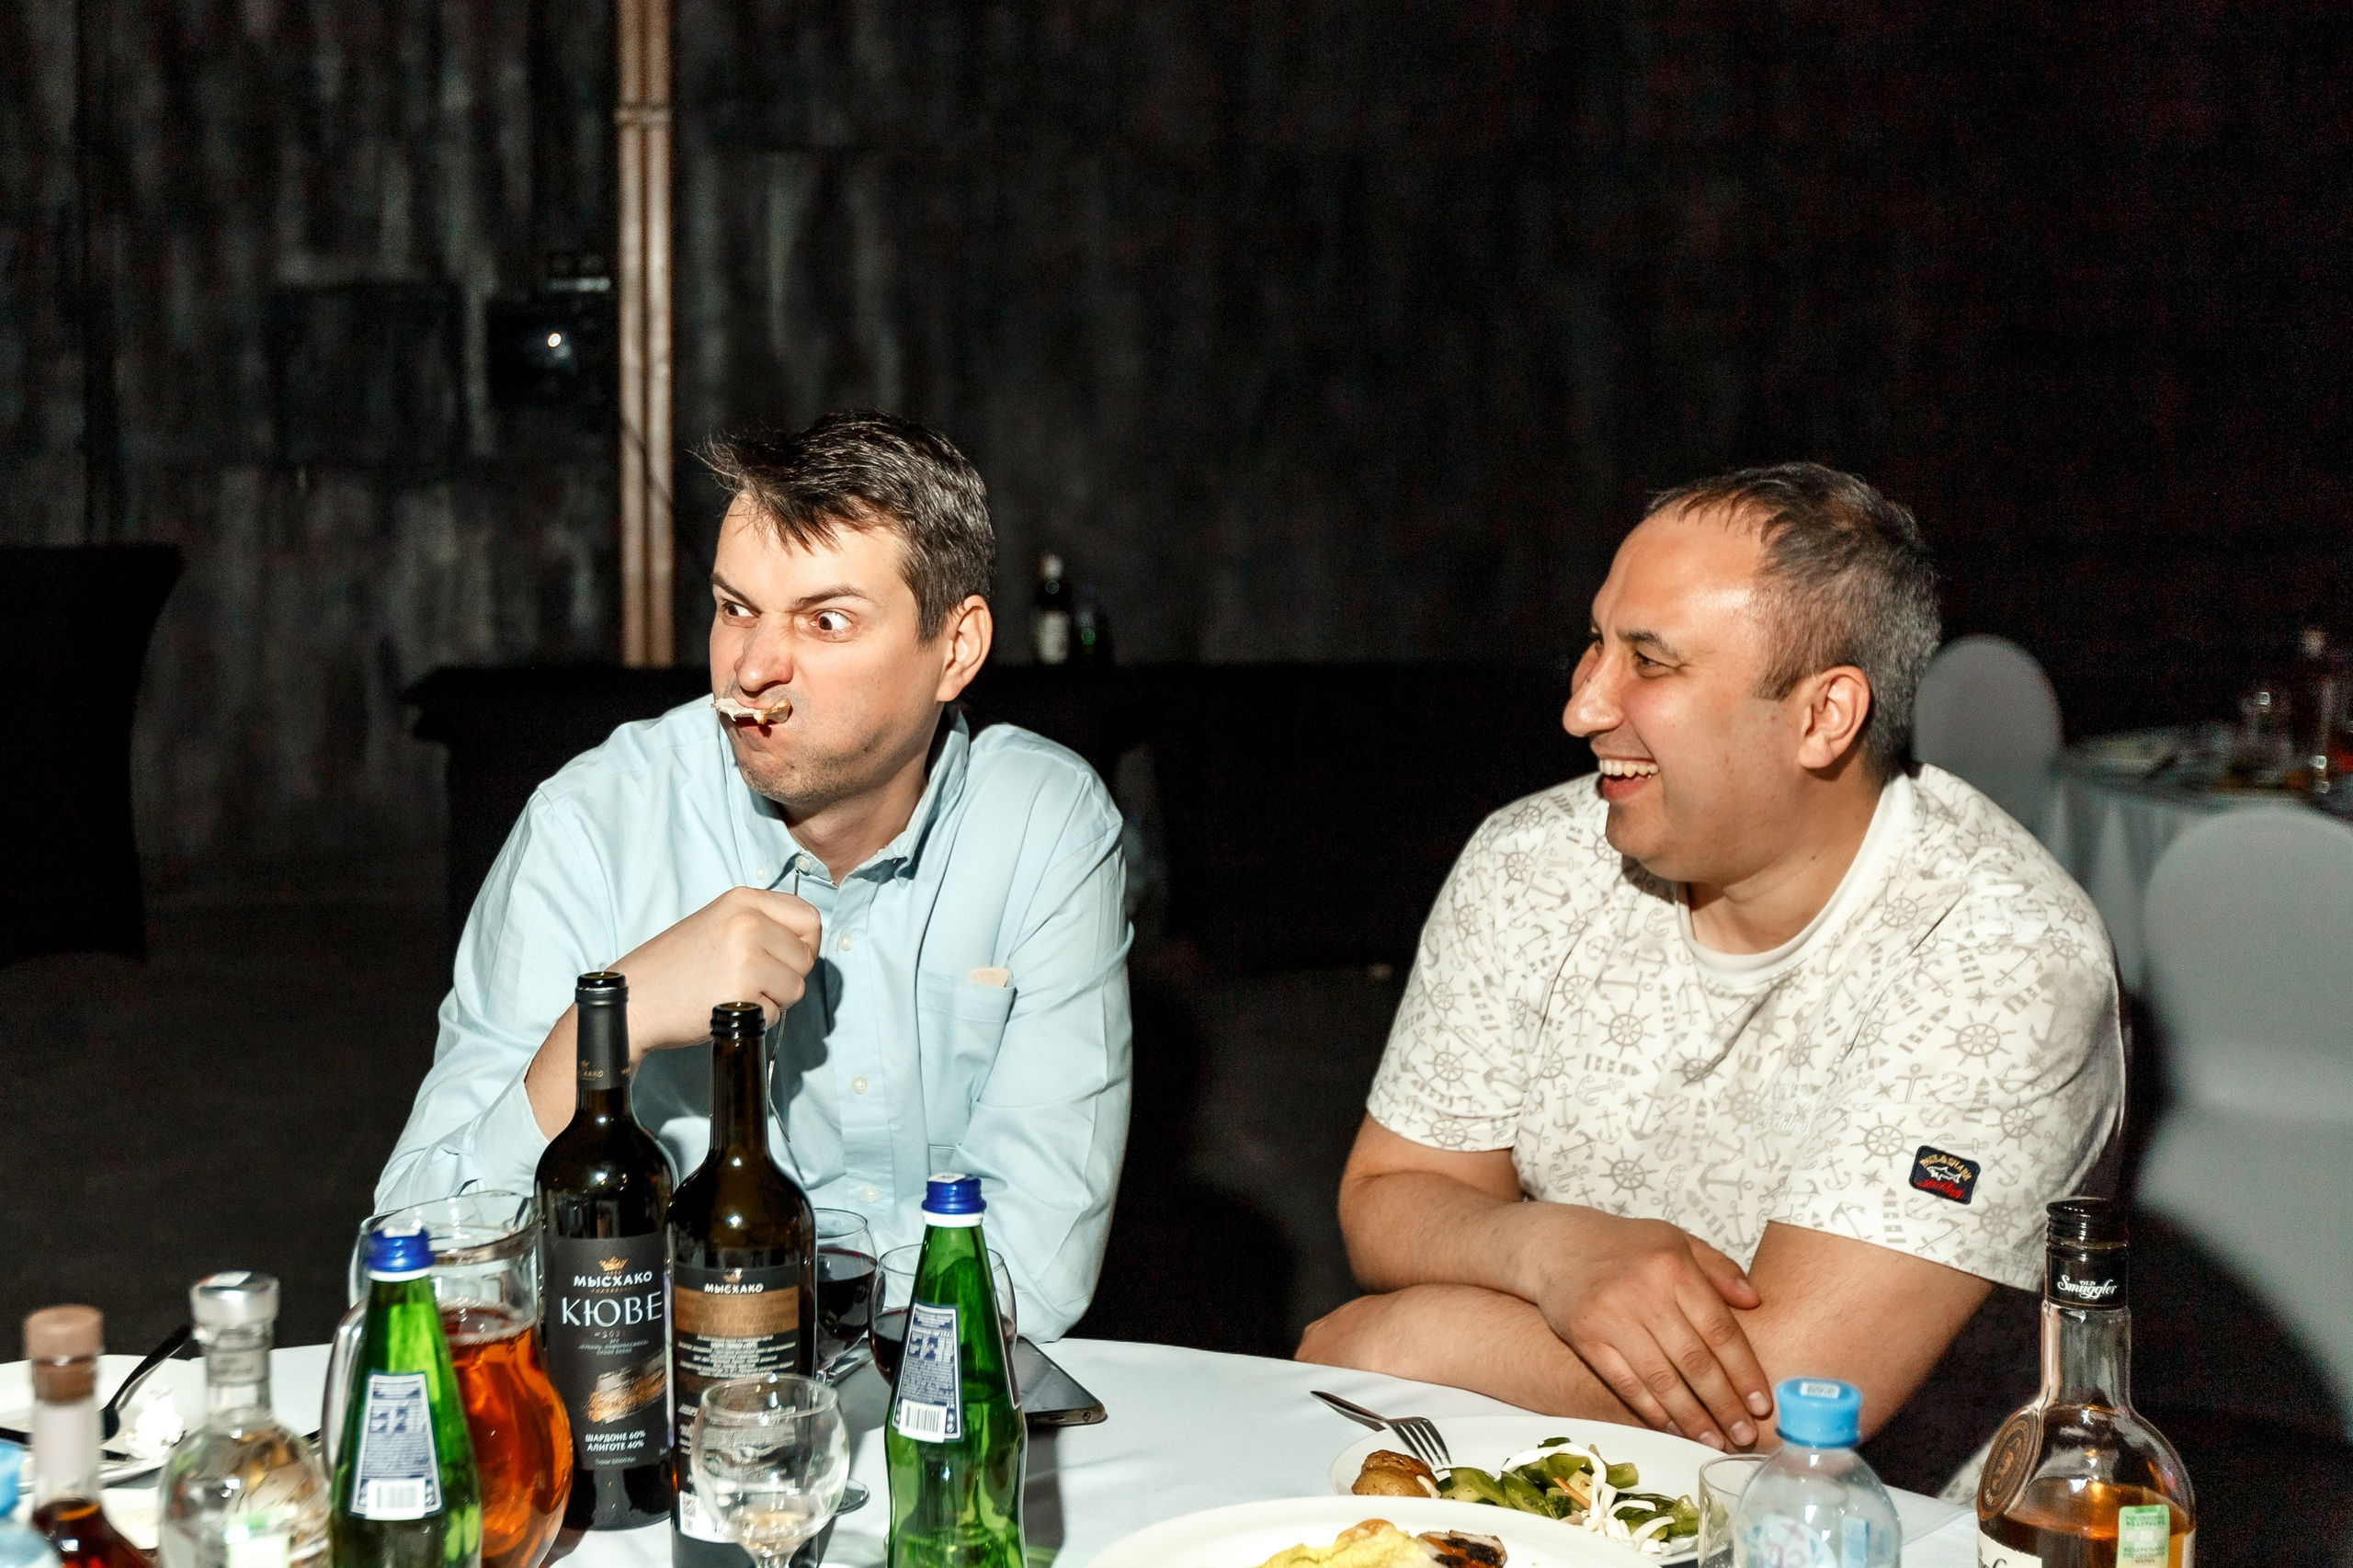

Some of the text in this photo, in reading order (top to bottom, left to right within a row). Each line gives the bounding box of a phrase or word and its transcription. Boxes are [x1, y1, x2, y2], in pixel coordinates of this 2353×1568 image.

[574, 1270, 654, 1288] МЫСХАКО
[2057, 1274, 2118, 1300] Smuggler
[704, 1283, 764, 1295] МЫСХАКО
[562, 1290, 663, 1328] КЮВЕ
[585, 1429, 646, 1443] ШАРДОНЕ 60%
[586, 1439, 645, 1452] АЛИГОТЕ 40%
